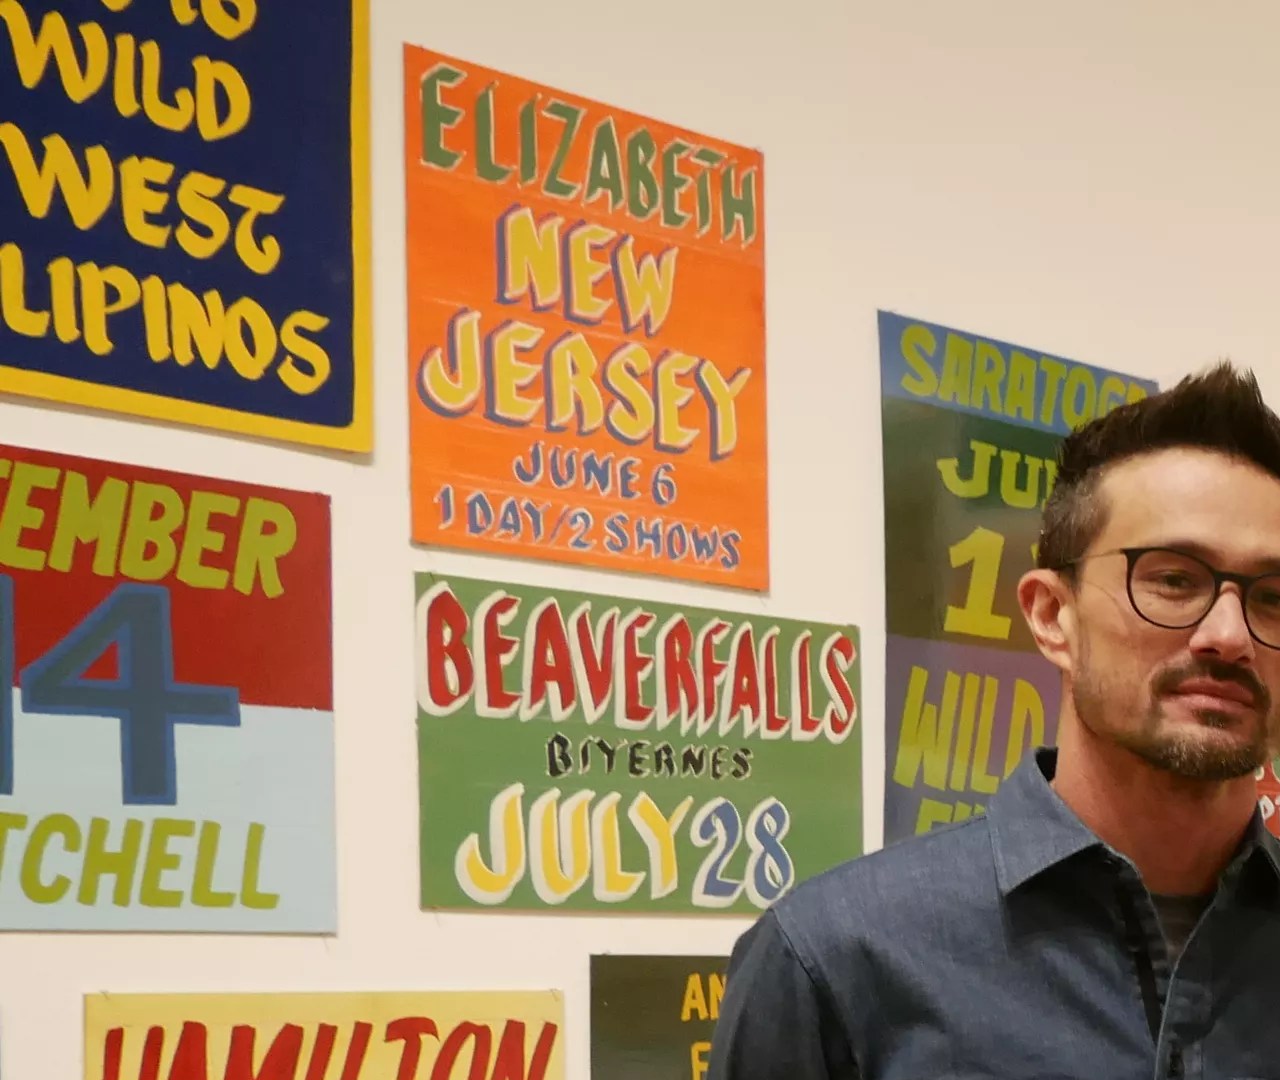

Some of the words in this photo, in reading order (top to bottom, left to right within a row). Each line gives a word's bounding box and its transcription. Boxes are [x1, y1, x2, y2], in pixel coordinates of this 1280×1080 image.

[0, 0, 251, 141] WILD
[0, 122, 285, 275] WEST
[419, 62, 757, 248] ELIZABETH
[0, 242, 331, 395] LIPINOS
[496, 202, 678, 338] NEW
[416, 306, 752, 462] JERSEY
[434, 484, 456, 530] 1
[604, 513, 743, 572] SHOWS
[513, 441, 642, 500] JUNE
[650, 463, 677, 506] 6
[943, 525, 1039, 640] 1
[545, 731, 754, 781] BIYERNES
[893, 665, 1044, 794] WILD
[455, 782, 694, 905] JULY
[689, 795, 795, 909] 28
